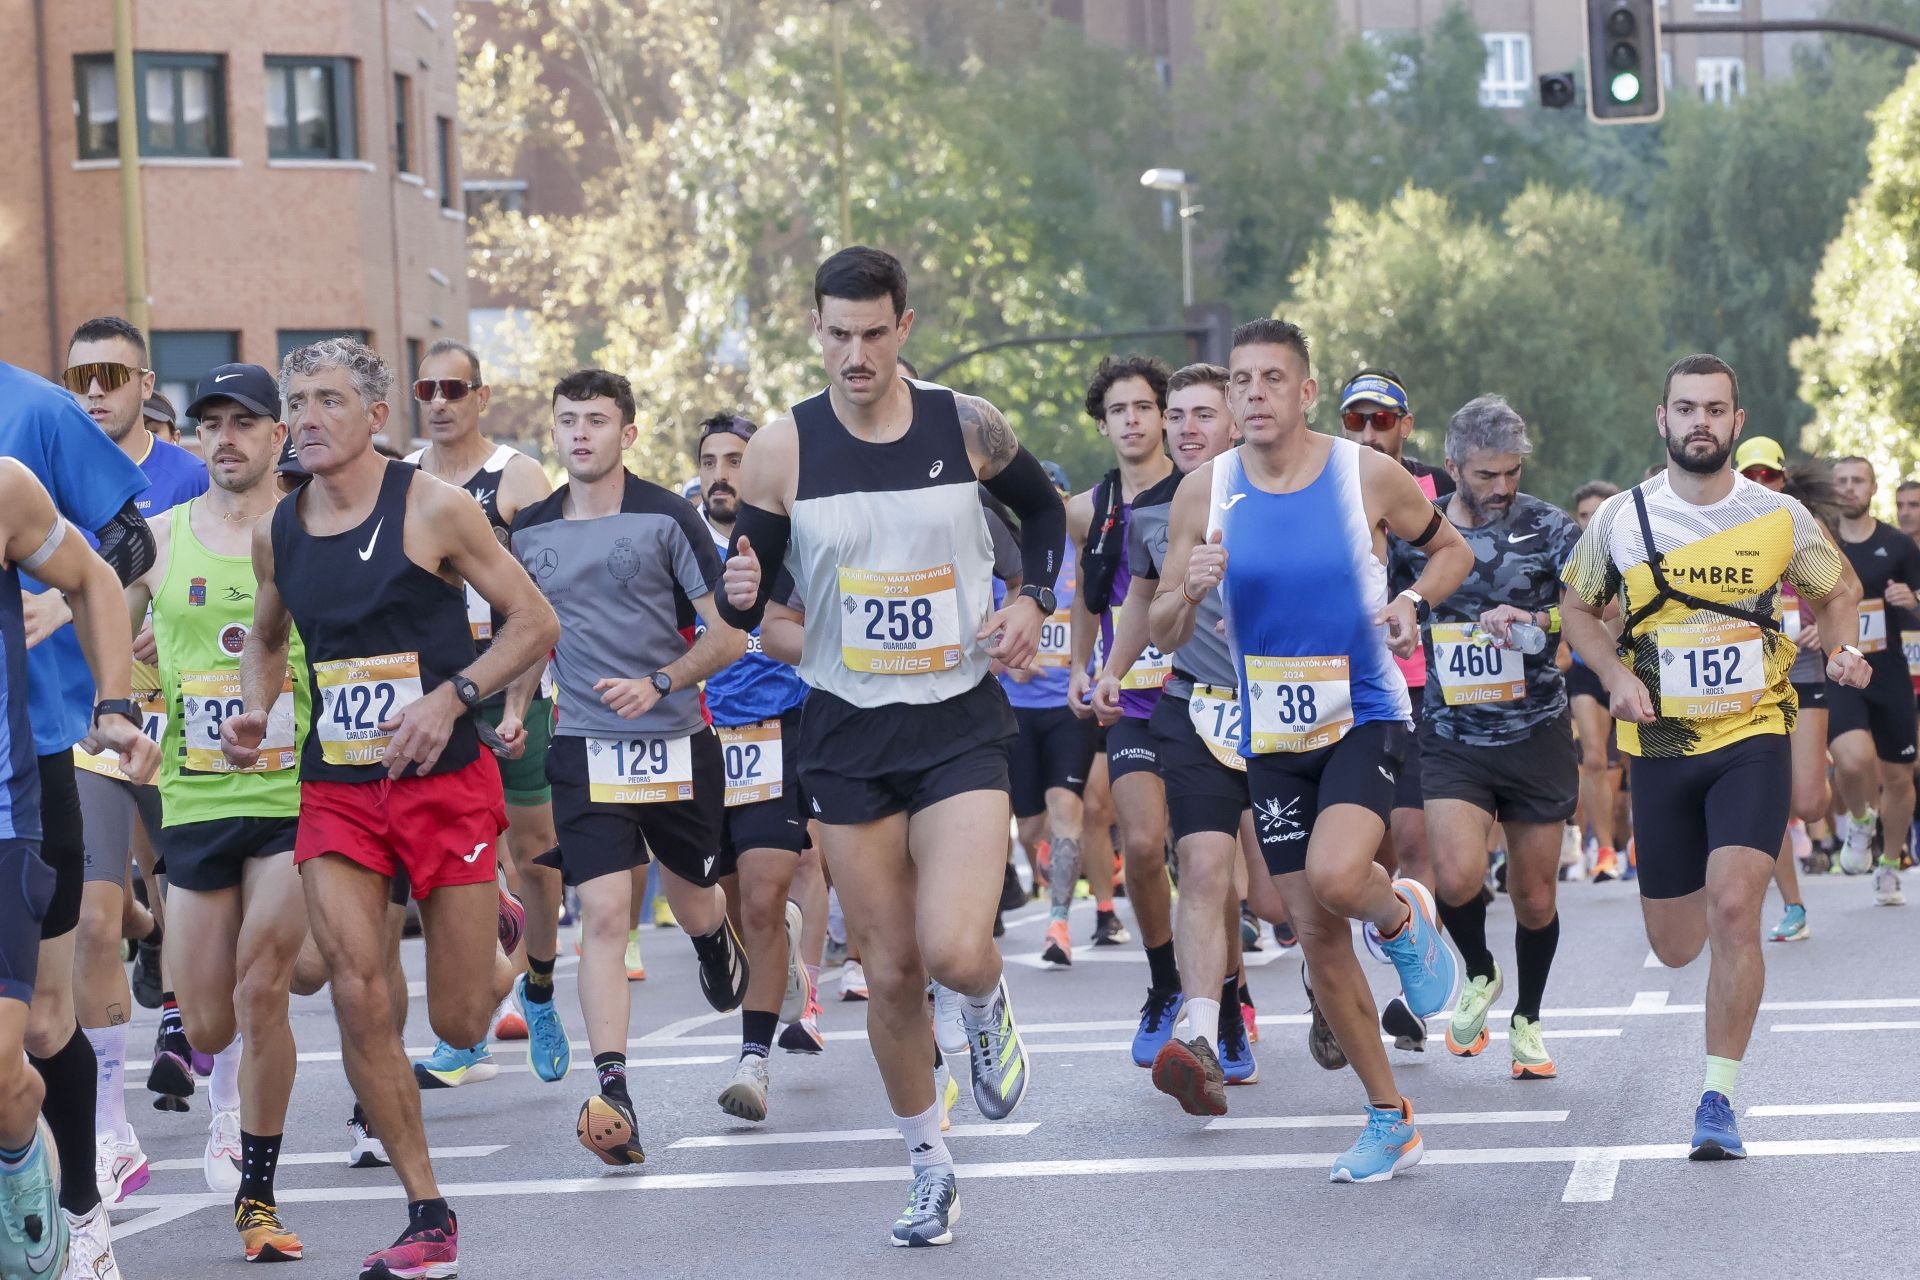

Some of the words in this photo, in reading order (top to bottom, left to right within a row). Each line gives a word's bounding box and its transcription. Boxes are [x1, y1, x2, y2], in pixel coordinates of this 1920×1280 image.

[863, 573, 886, 582] MEDIA
[887, 572, 926, 583] MARATÓN
[927, 565, 952, 578] AVILÉS
[884, 586, 910, 594] 2024
[864, 598, 934, 641] 258
[882, 641, 917, 650] GUARDADO
[1699, 635, 1721, 645] 2024
[1285, 658, 1320, 667] MARATÓN
[1449, 643, 1503, 677] 460
[1683, 645, 1743, 688] 152
[1282, 671, 1305, 679] 2024
[222, 684, 241, 693] 202
[1706, 687, 1725, 696] ROCES
[333, 682, 396, 731] 422
[1277, 684, 1317, 724] 38
[1292, 724, 1306, 732] DANI
[346, 731, 368, 741] CARLOS
[345, 744, 386, 761] avilé
[611, 738, 668, 777] 129
[725, 743, 762, 780] 02
[627, 776, 651, 784] PIEDRAS
[1262, 830, 1309, 844] WOLVES
